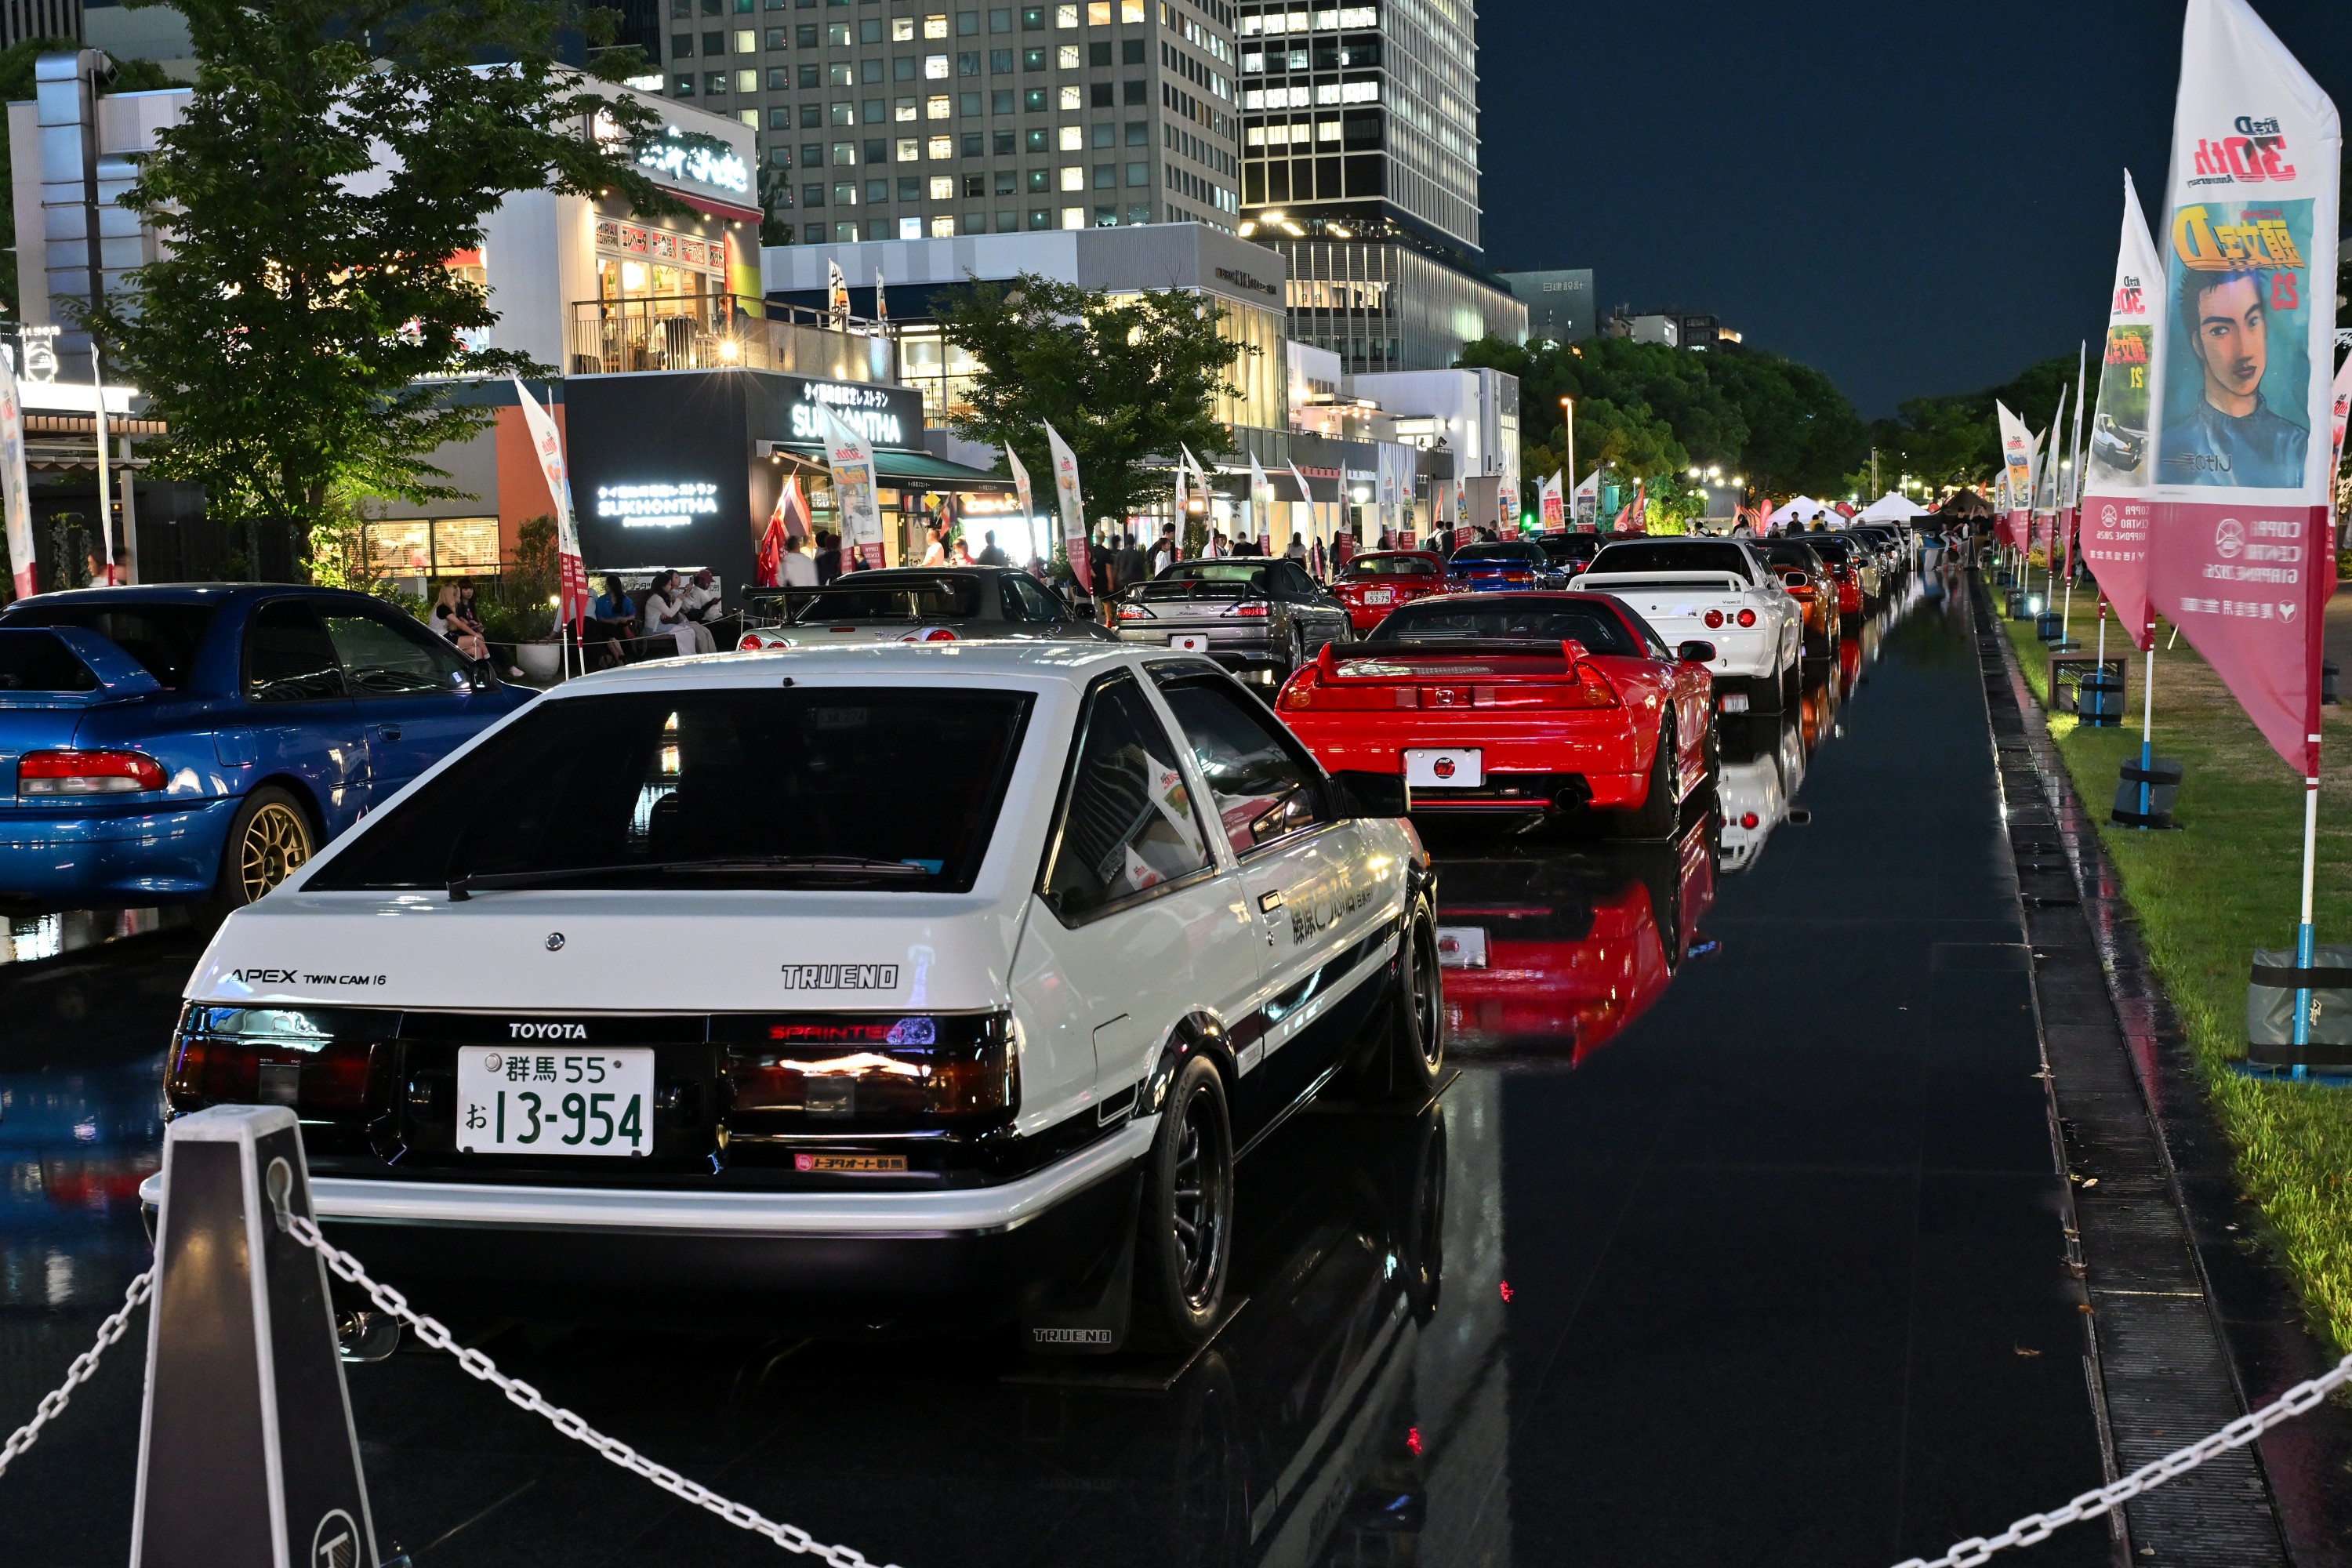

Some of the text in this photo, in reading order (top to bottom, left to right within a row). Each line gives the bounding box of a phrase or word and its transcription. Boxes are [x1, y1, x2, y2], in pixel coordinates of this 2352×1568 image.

[597, 220, 619, 237] MIRAI
[1543, 281, 1584, 292] 日建設計
[597, 497, 718, 517] SUKHONTHA
[227, 969, 387, 985] APEX TWIN CAM 16
[782, 964, 899, 989] TRUENO
[509, 1023, 587, 1039] TOYOTA
[506, 1055, 605, 1083] 群馬 55
[466, 1091, 643, 1147] お 13-954
[1033, 1327, 1112, 1343] TRUENO
